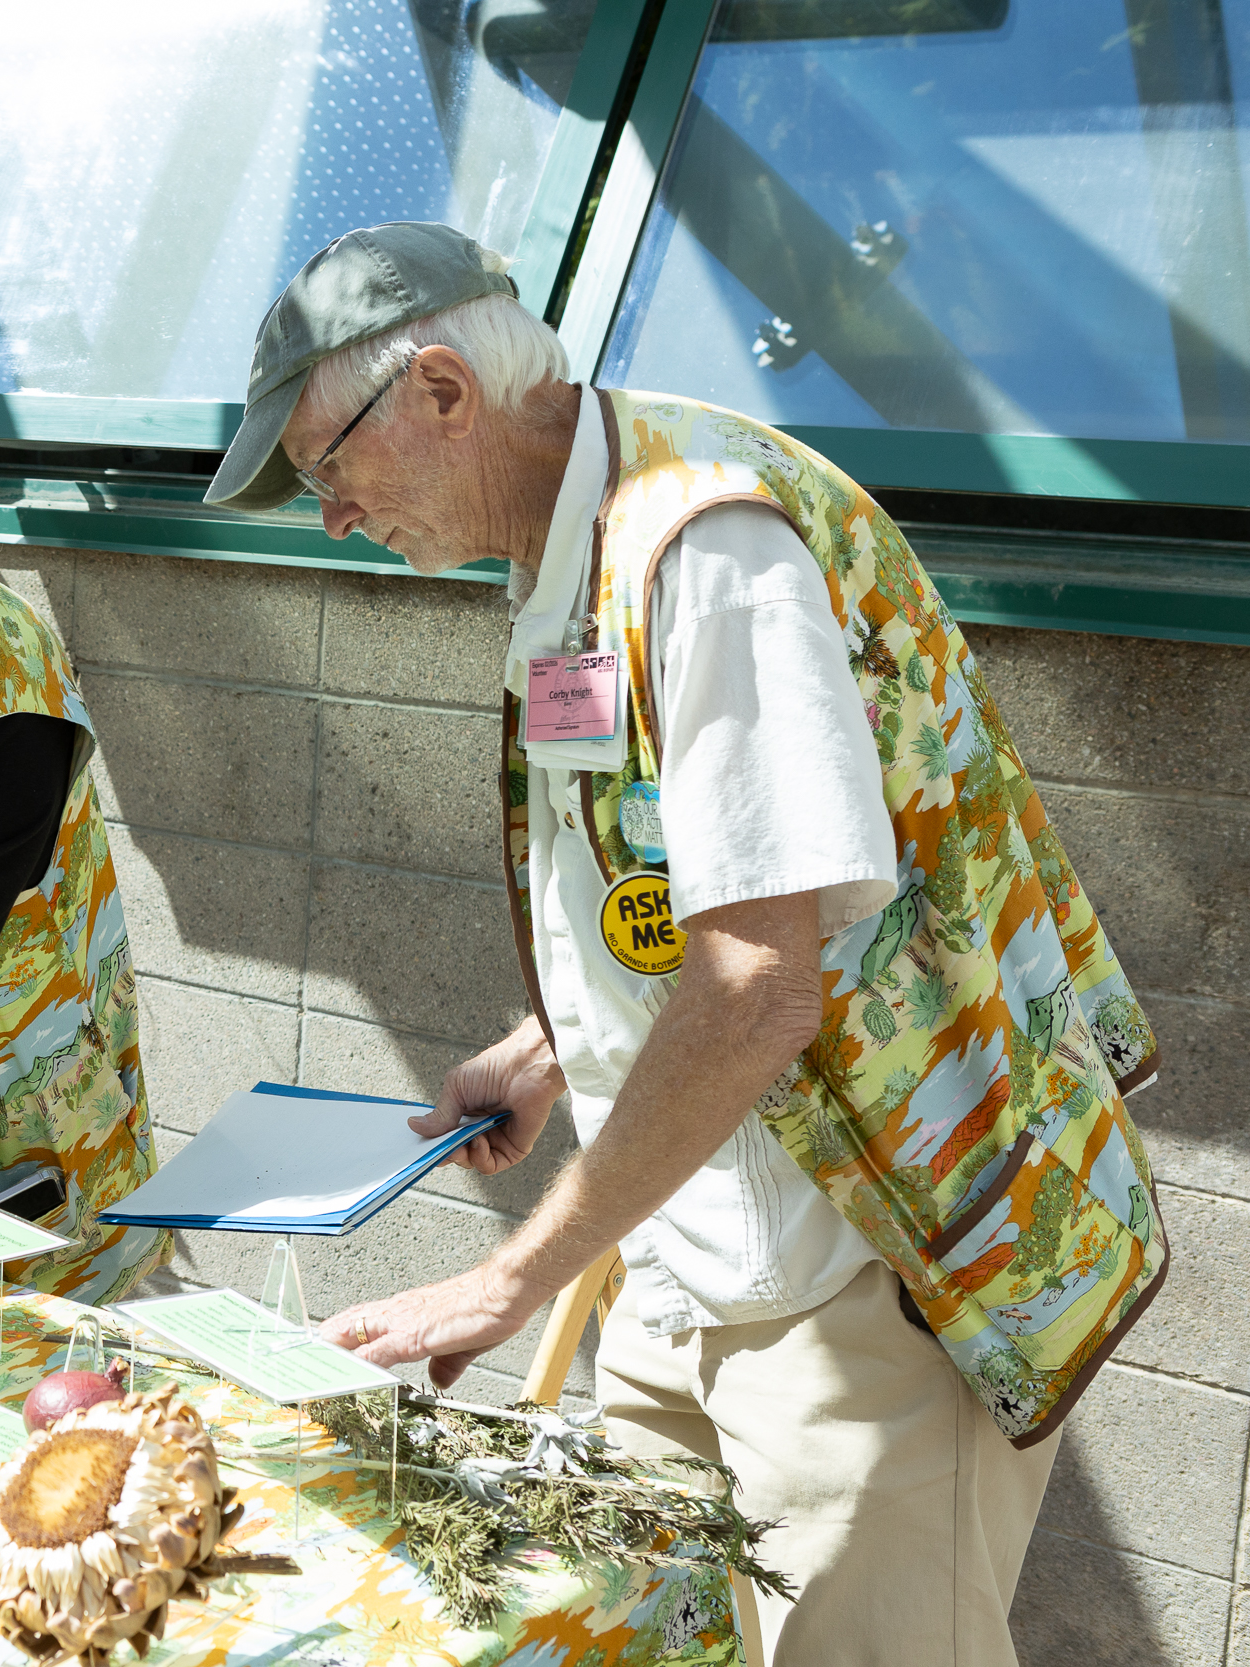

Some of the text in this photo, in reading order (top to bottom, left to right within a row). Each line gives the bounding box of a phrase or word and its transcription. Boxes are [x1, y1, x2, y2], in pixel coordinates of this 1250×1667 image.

[549, 687, 592, 700] Corby Knight
[644, 802, 658, 816] OUR
[646, 817, 662, 831] ACTI
[645, 830, 663, 844] MATT
[632, 919, 676, 951] ME
[608, 932, 684, 970] RIO GRANDE BOTANIC
